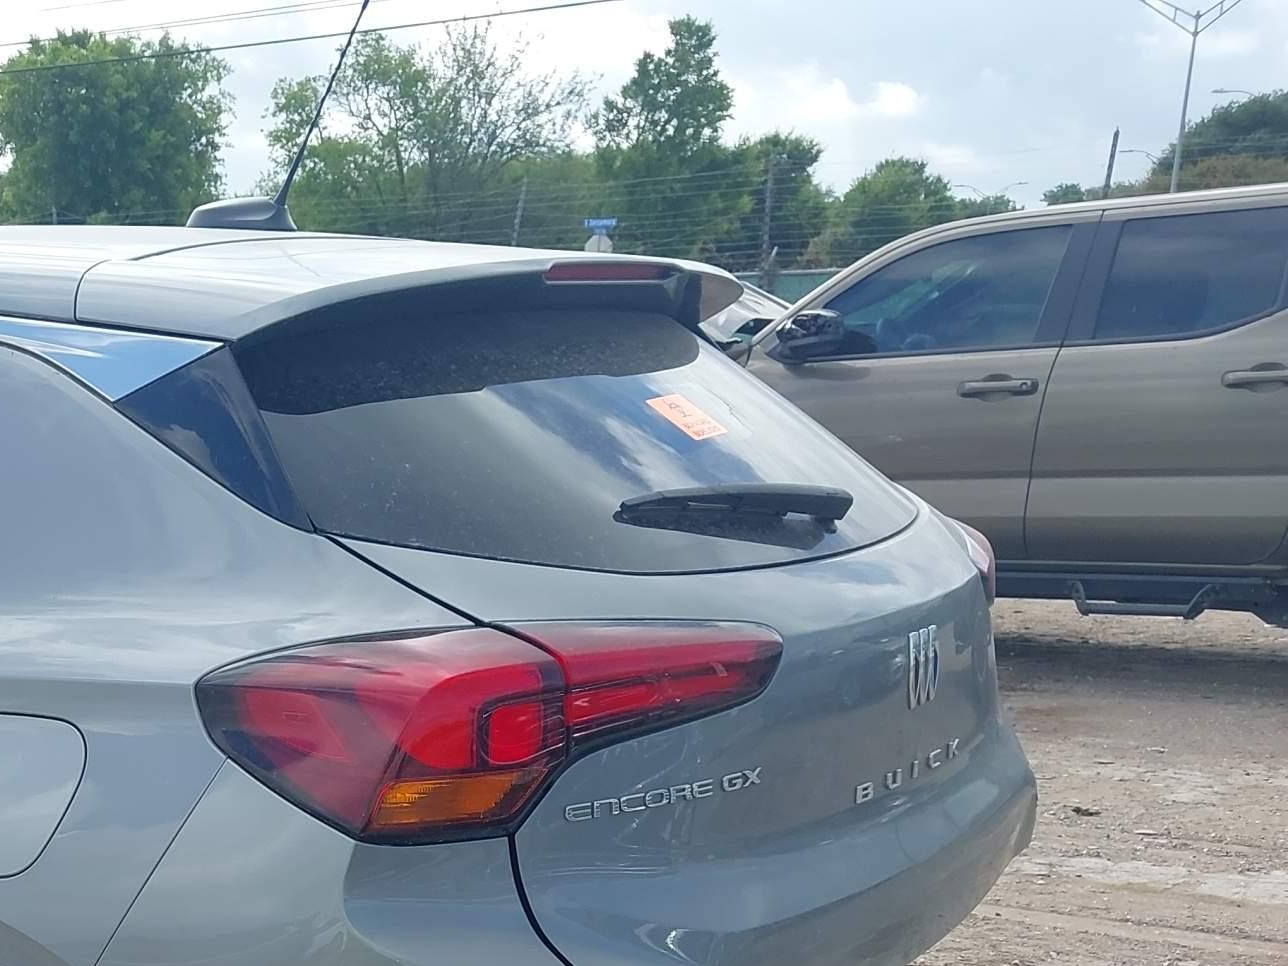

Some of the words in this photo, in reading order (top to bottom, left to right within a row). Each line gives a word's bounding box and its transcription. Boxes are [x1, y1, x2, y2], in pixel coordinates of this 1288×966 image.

[564, 779, 714, 822] ENCORE
[722, 767, 762, 792] GX
[855, 738, 960, 804] BUICK
